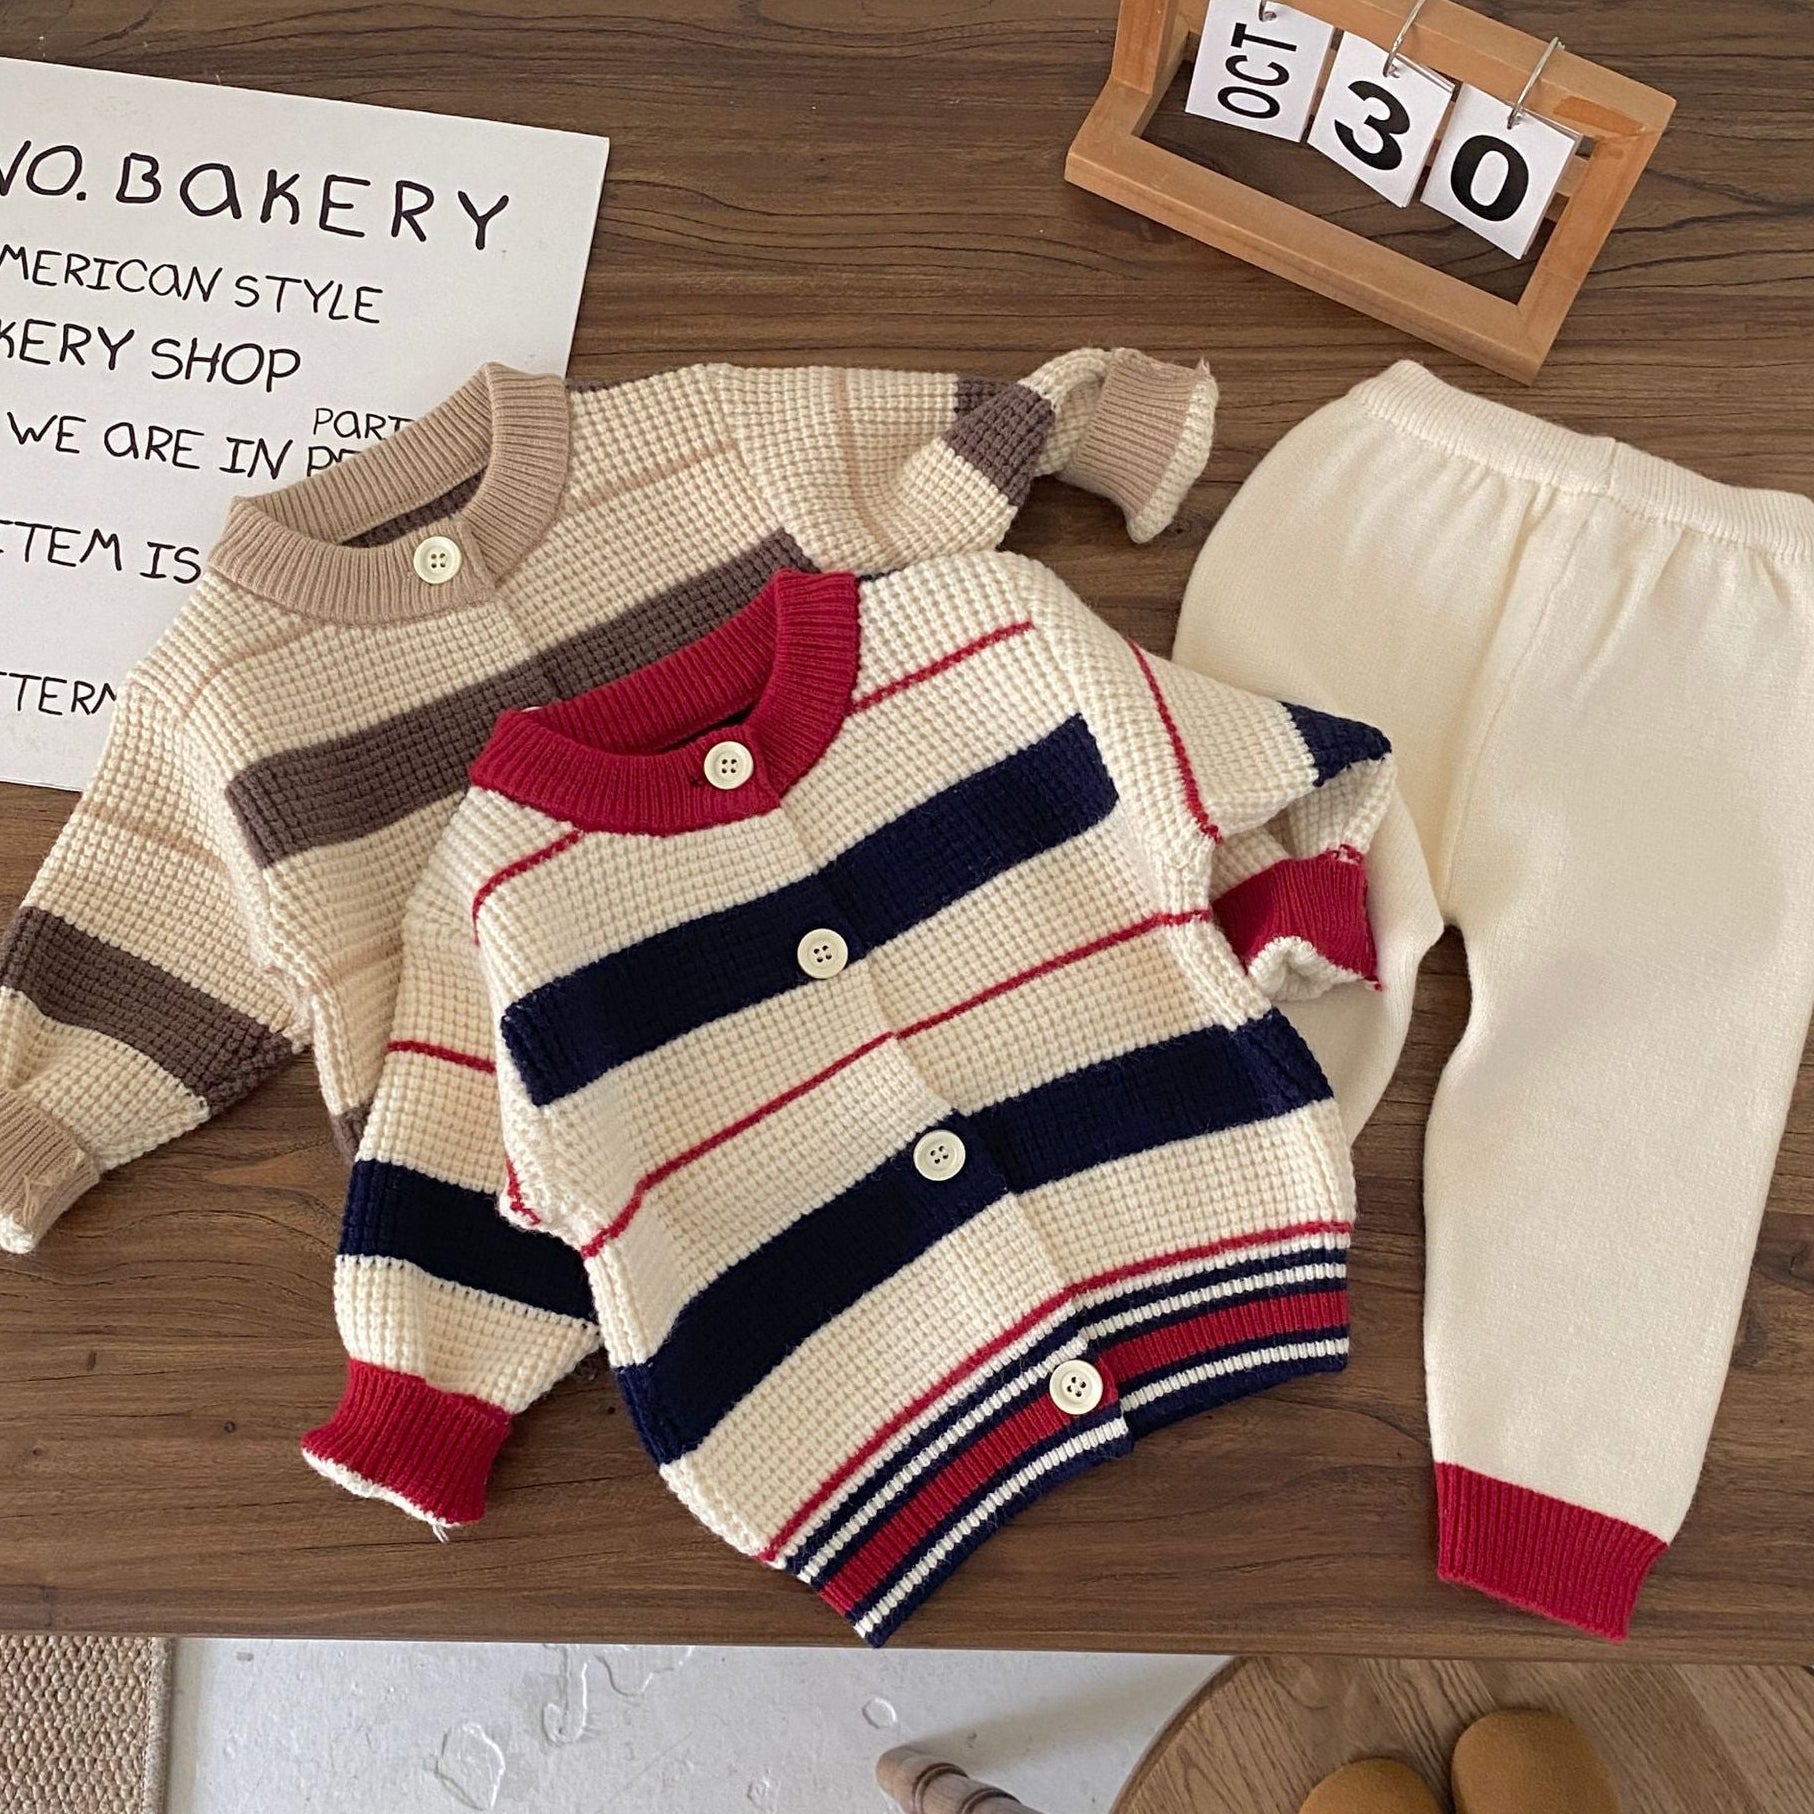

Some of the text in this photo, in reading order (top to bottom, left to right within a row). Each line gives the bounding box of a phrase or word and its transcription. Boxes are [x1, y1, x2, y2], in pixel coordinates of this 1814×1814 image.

[1216, 22, 1298, 119] OCT
[234, 275, 384, 324] STYLE
[151, 337, 301, 393] SHOP
[6, 411, 87, 454] WE
[218, 436, 294, 480] IN
[139, 541, 202, 585] IS
